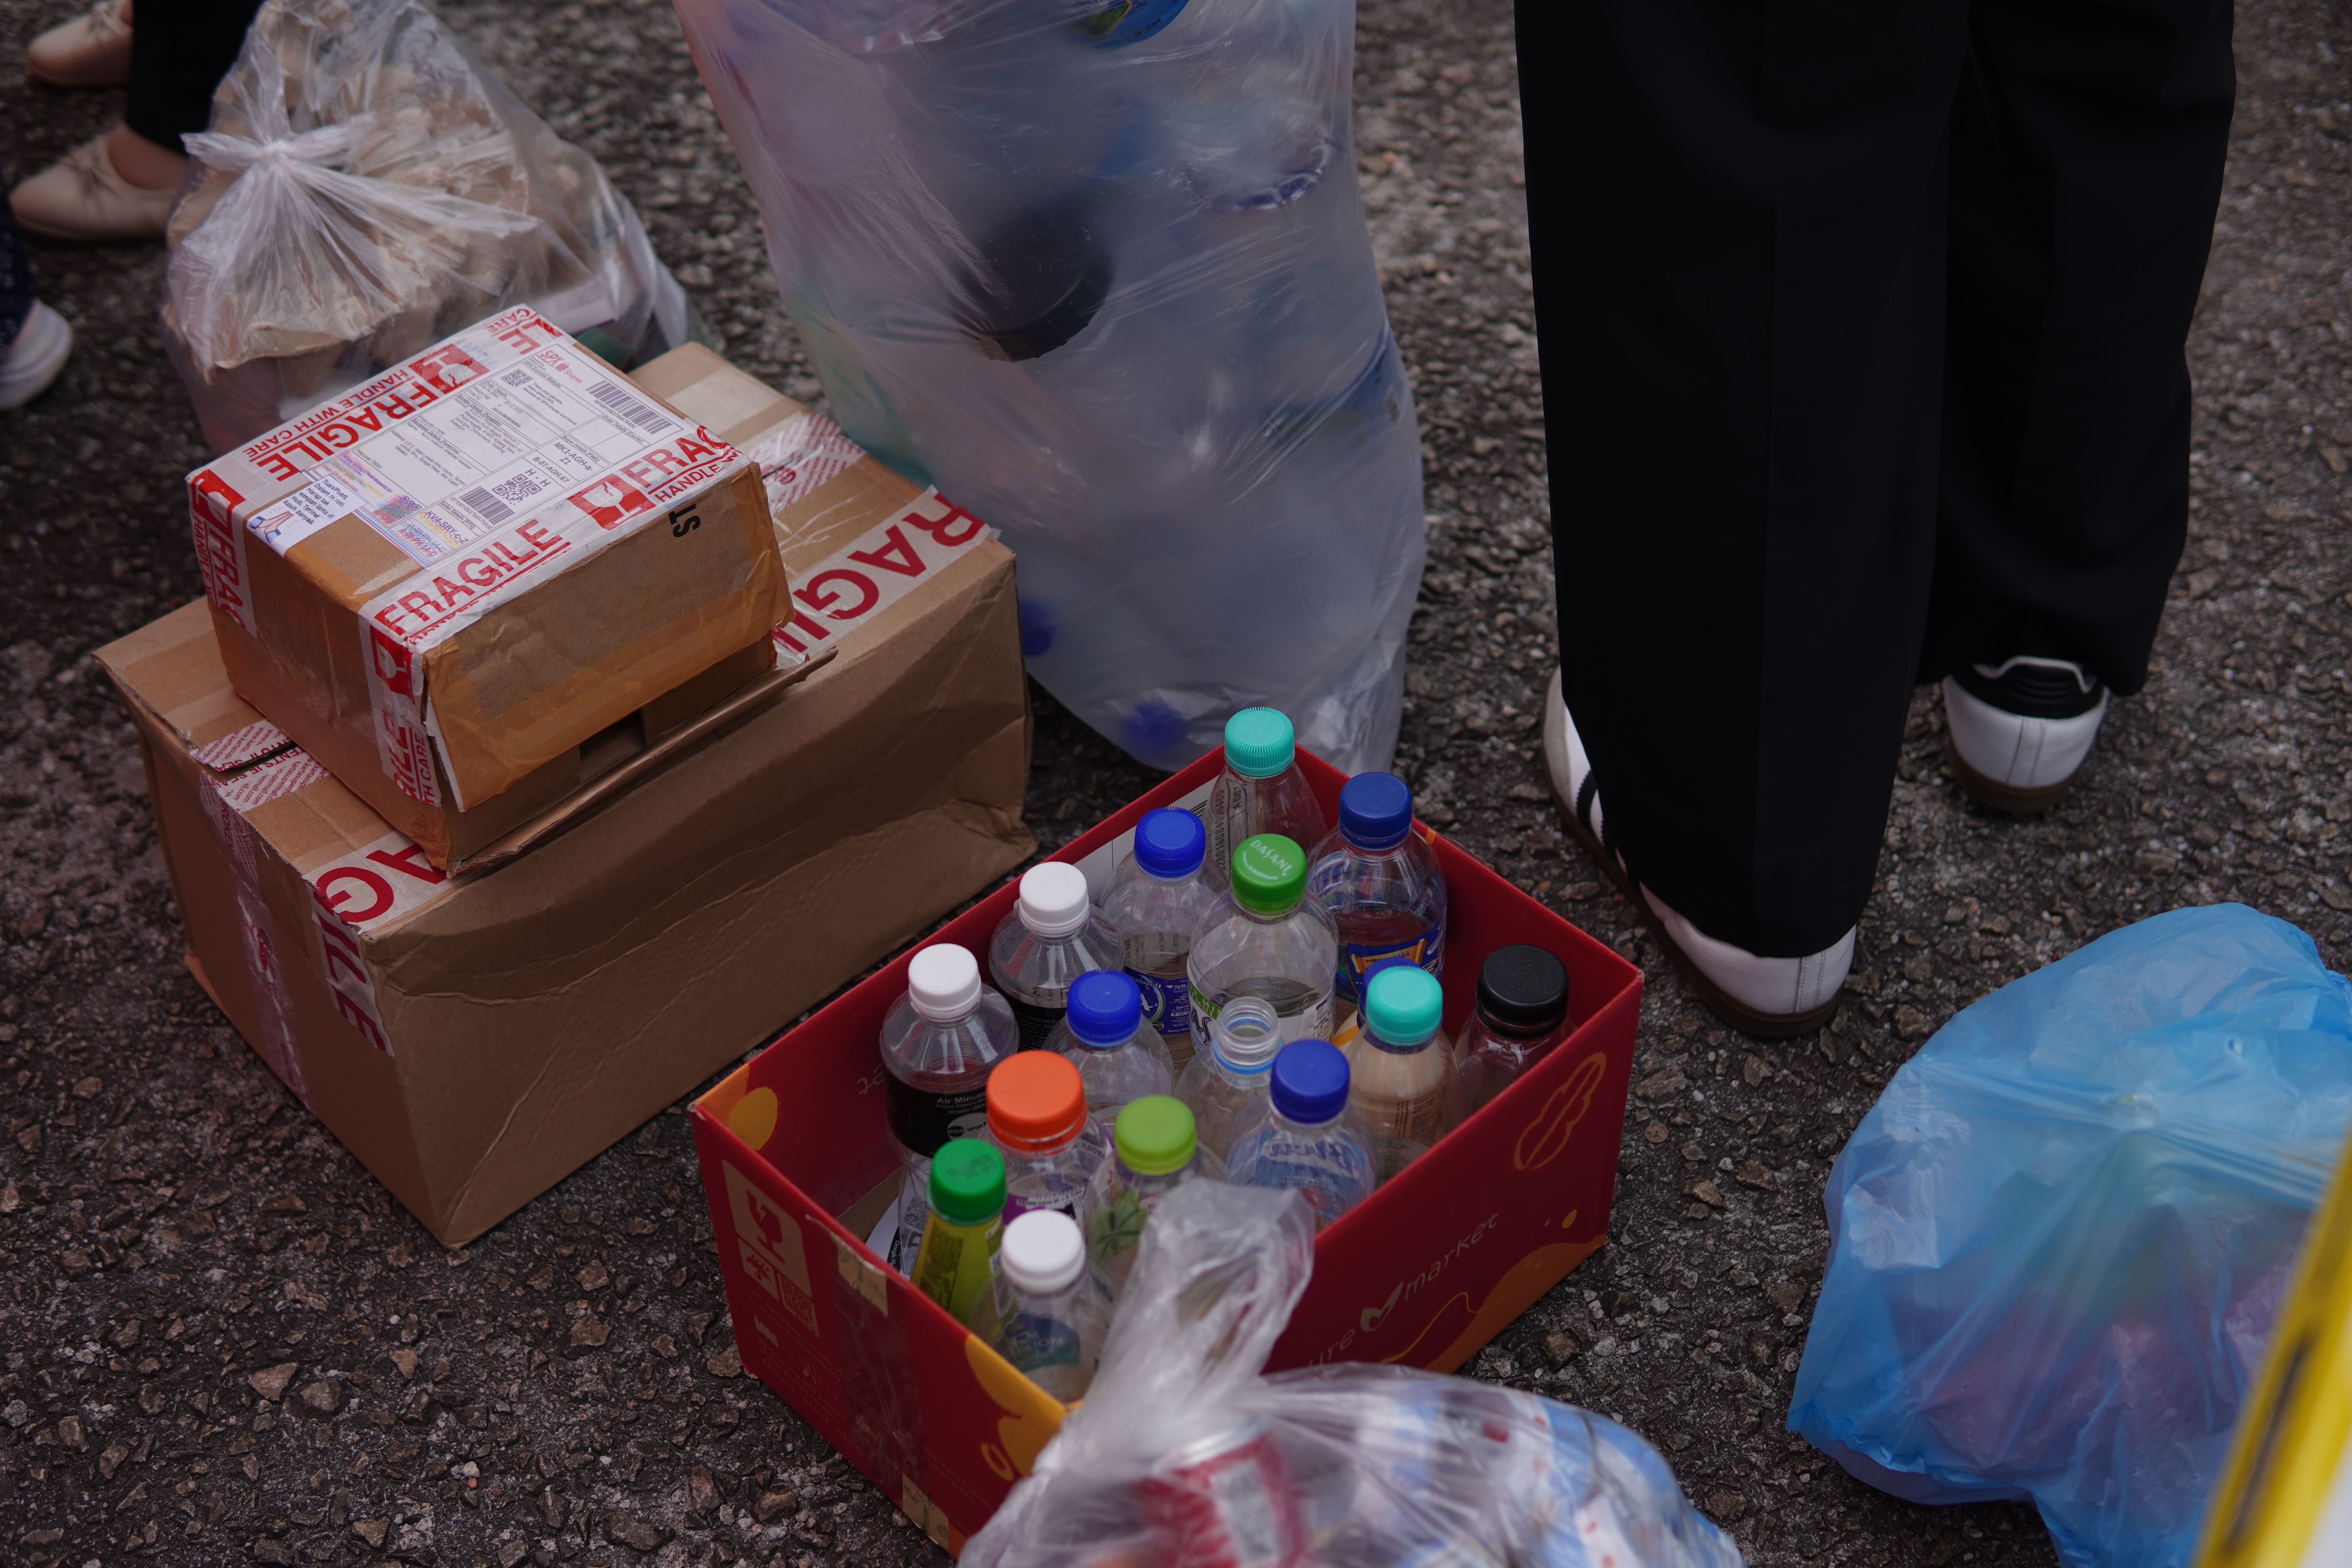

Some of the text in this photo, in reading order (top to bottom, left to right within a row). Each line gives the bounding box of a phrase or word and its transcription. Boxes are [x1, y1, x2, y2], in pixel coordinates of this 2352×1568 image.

[485, 308, 530, 333] CARE
[540, 350, 582, 383] SPX Shopee
[483, 380, 507, 397] Order Details
[523, 387, 536, 397] become
[548, 405, 560, 414] courier
[242, 369, 410, 458] HANDLE WITH CARE
[469, 403, 483, 414] Details
[257, 380, 438, 482] FRAGILE
[427, 430, 441, 441] Details
[482, 430, 494, 438] 47650
[492, 437, 506, 448] Subang
[602, 415, 644, 444] Order Details (Courier)
[554, 442, 592, 470] MK1-AGH-a-
[561, 436, 599, 463] Buyer Details (FWD)
[454, 476, 466, 485] Taman
[533, 457, 569, 482] B-07-AGH.67
[306, 487, 321, 499] Harap
[314, 483, 330, 495] Dalam
[334, 499, 345, 507] roti.
[323, 479, 348, 499] Tuan/Puan,
[655, 464, 725, 503] HANDLE
[283, 500, 297, 511] kasih
[291, 495, 319, 518] Hub. Terima
[298, 492, 317, 505] simpan
[316, 504, 328, 515] lama
[439, 501, 475, 529] Seller Details (RTS)
[374, 519, 563, 636] FRAGILE
[414, 732, 432, 782] CARE
[1405, 1213, 1499, 1301] market
